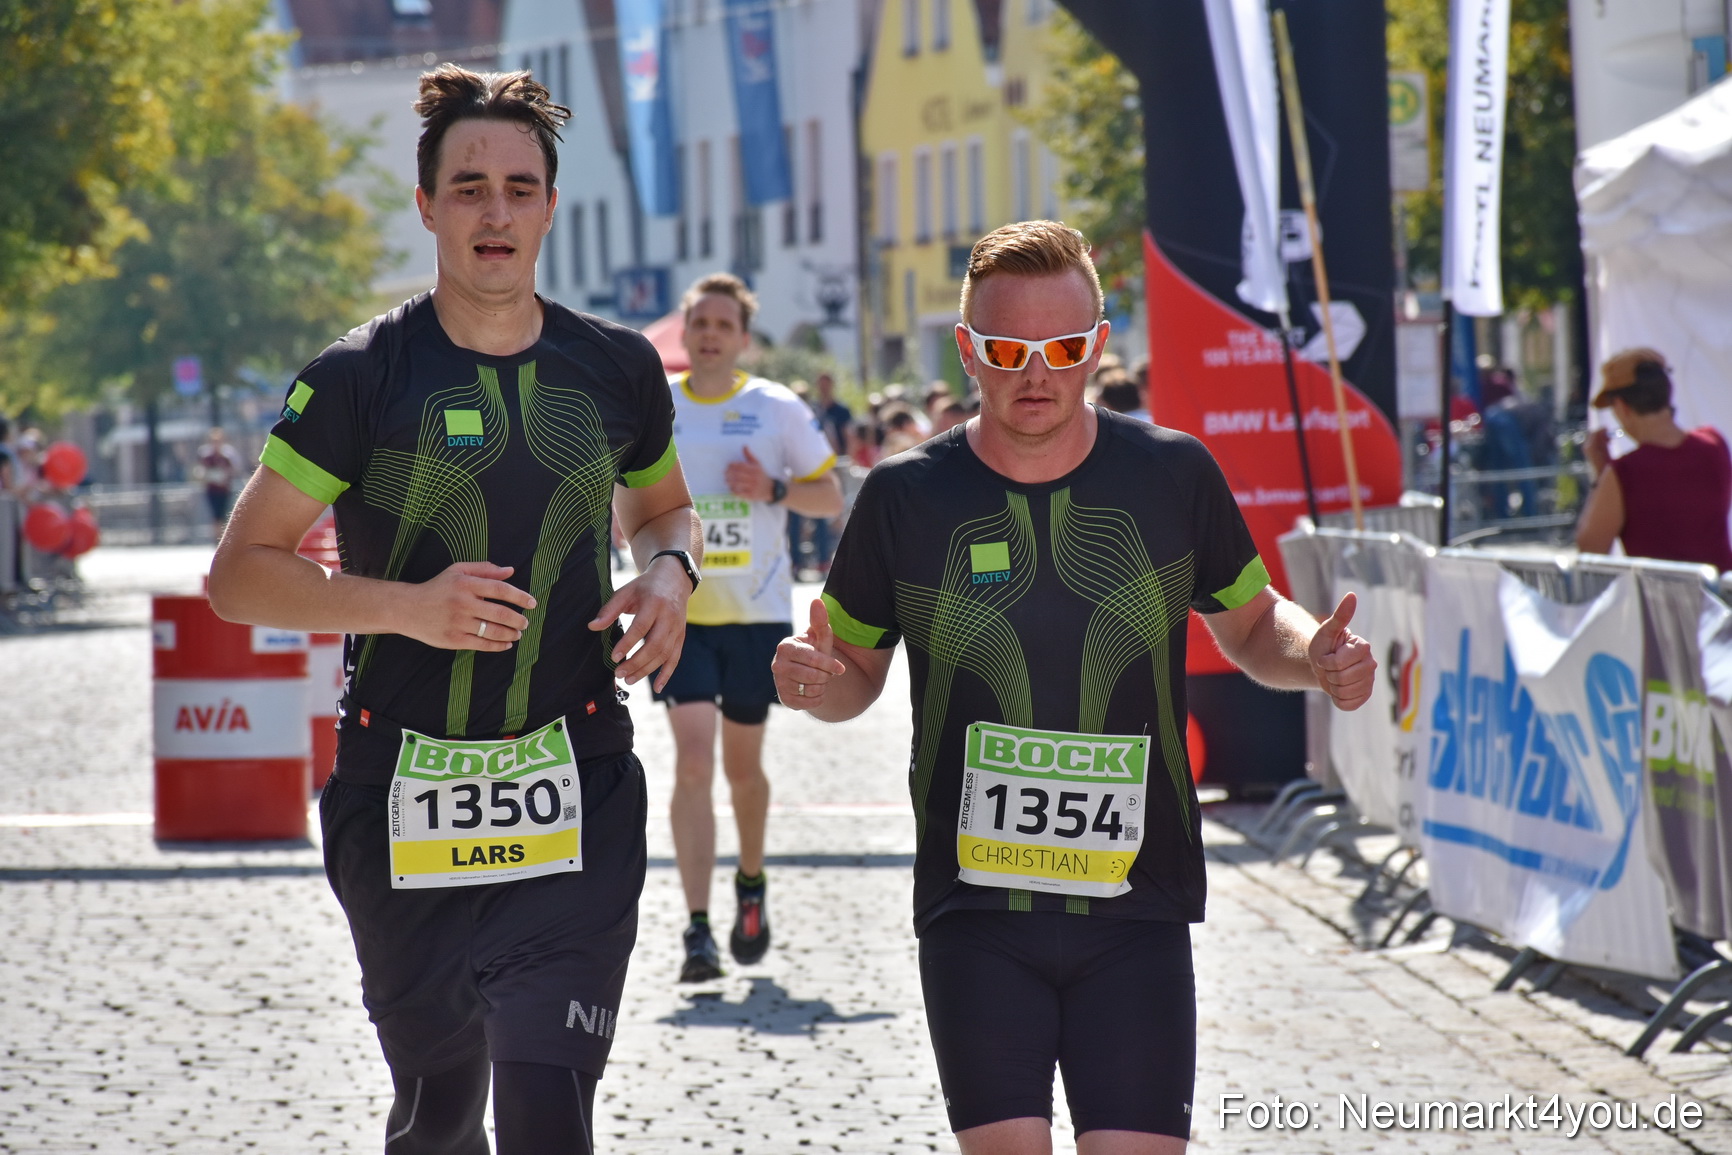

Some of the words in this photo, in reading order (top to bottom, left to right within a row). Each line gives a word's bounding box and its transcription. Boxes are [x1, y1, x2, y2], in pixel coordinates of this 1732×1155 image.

[1204, 411, 1263, 435] BMW
[447, 436, 484, 447] DATEV
[706, 522, 742, 547] 45
[972, 571, 1011, 584] DATEV
[410, 731, 554, 777] BOCK
[981, 731, 1131, 777] BOCK
[414, 778, 561, 830] 1350
[985, 784, 1122, 841] 1354
[451, 844, 526, 867] LARS
[971, 844, 1089, 875] CHRISTIAN
[565, 1000, 617, 1041] NIK
